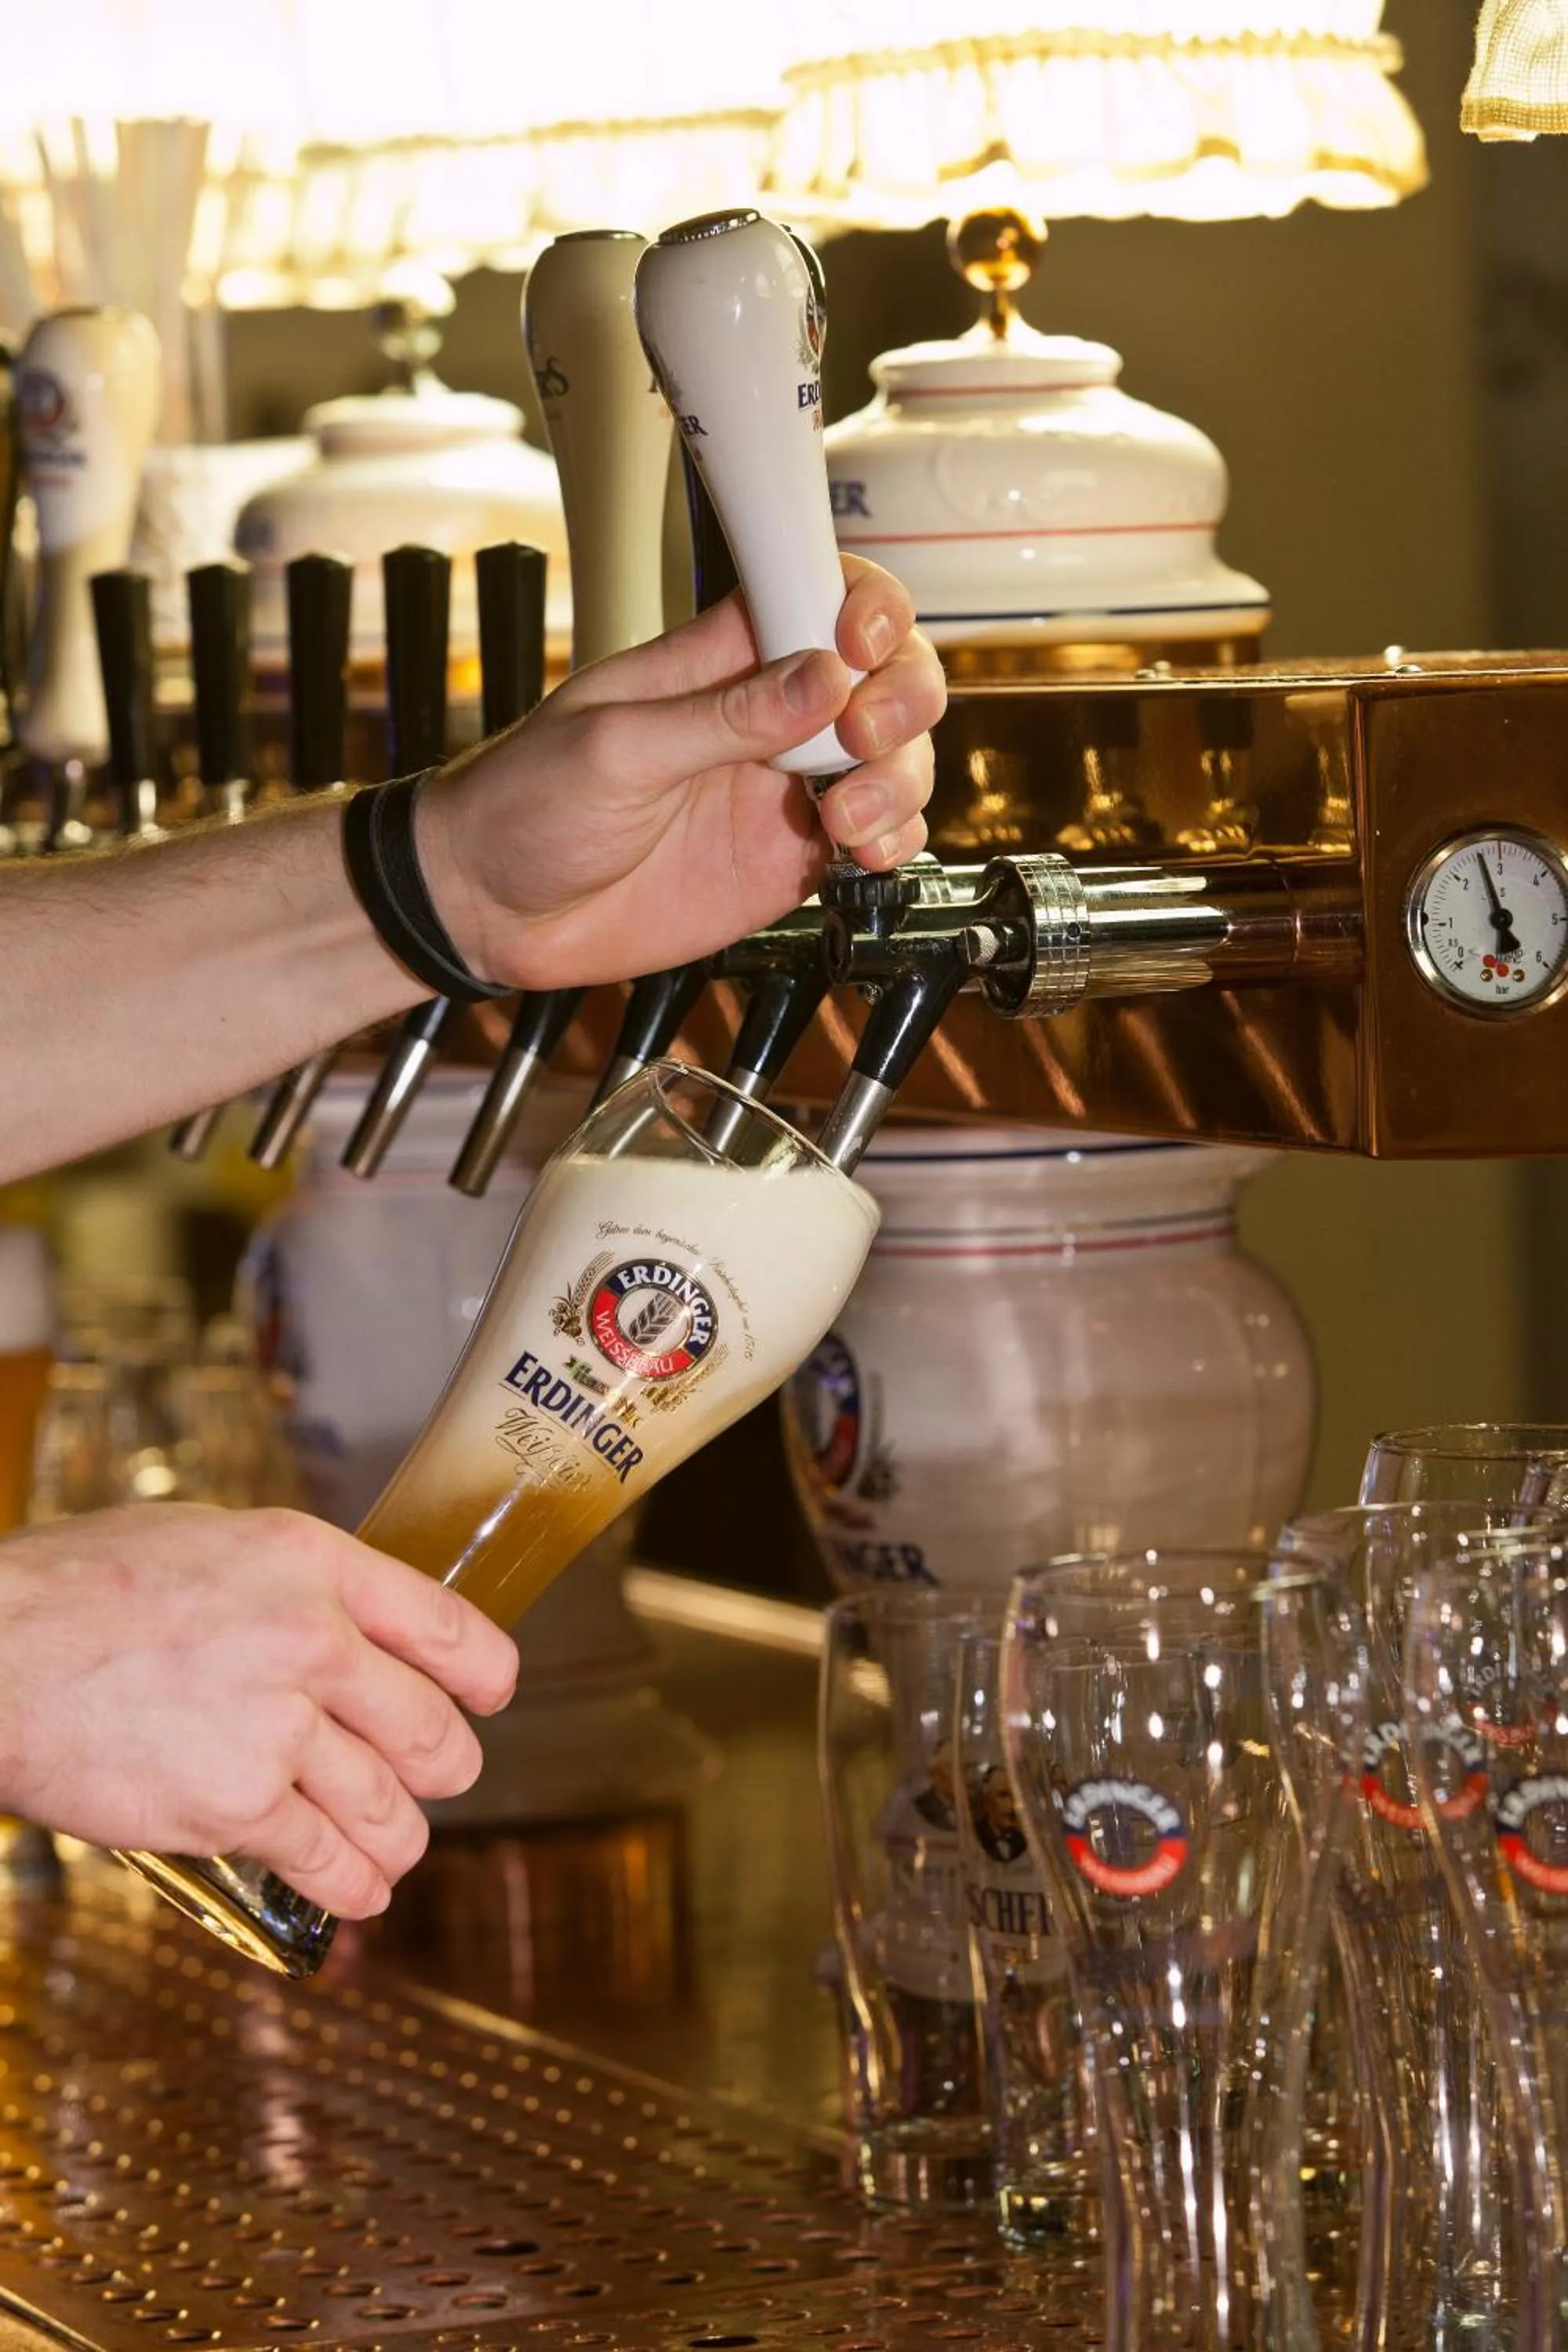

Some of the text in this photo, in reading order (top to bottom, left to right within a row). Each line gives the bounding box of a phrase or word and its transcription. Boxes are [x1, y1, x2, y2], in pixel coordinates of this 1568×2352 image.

[1497, 863, 1503, 876] 3
[1462, 877, 1469, 891] 2
[1533, 874, 1540, 887] 4
[1448, 917, 1454, 928] 1
[1552, 914, 1559, 926] 5
[1457, 946, 1464, 957] 0
[1536, 951, 1542, 963] 6
[616, 1265, 712, 1345] ERDINGER
[503, 1352, 644, 1483] ERDINGER
